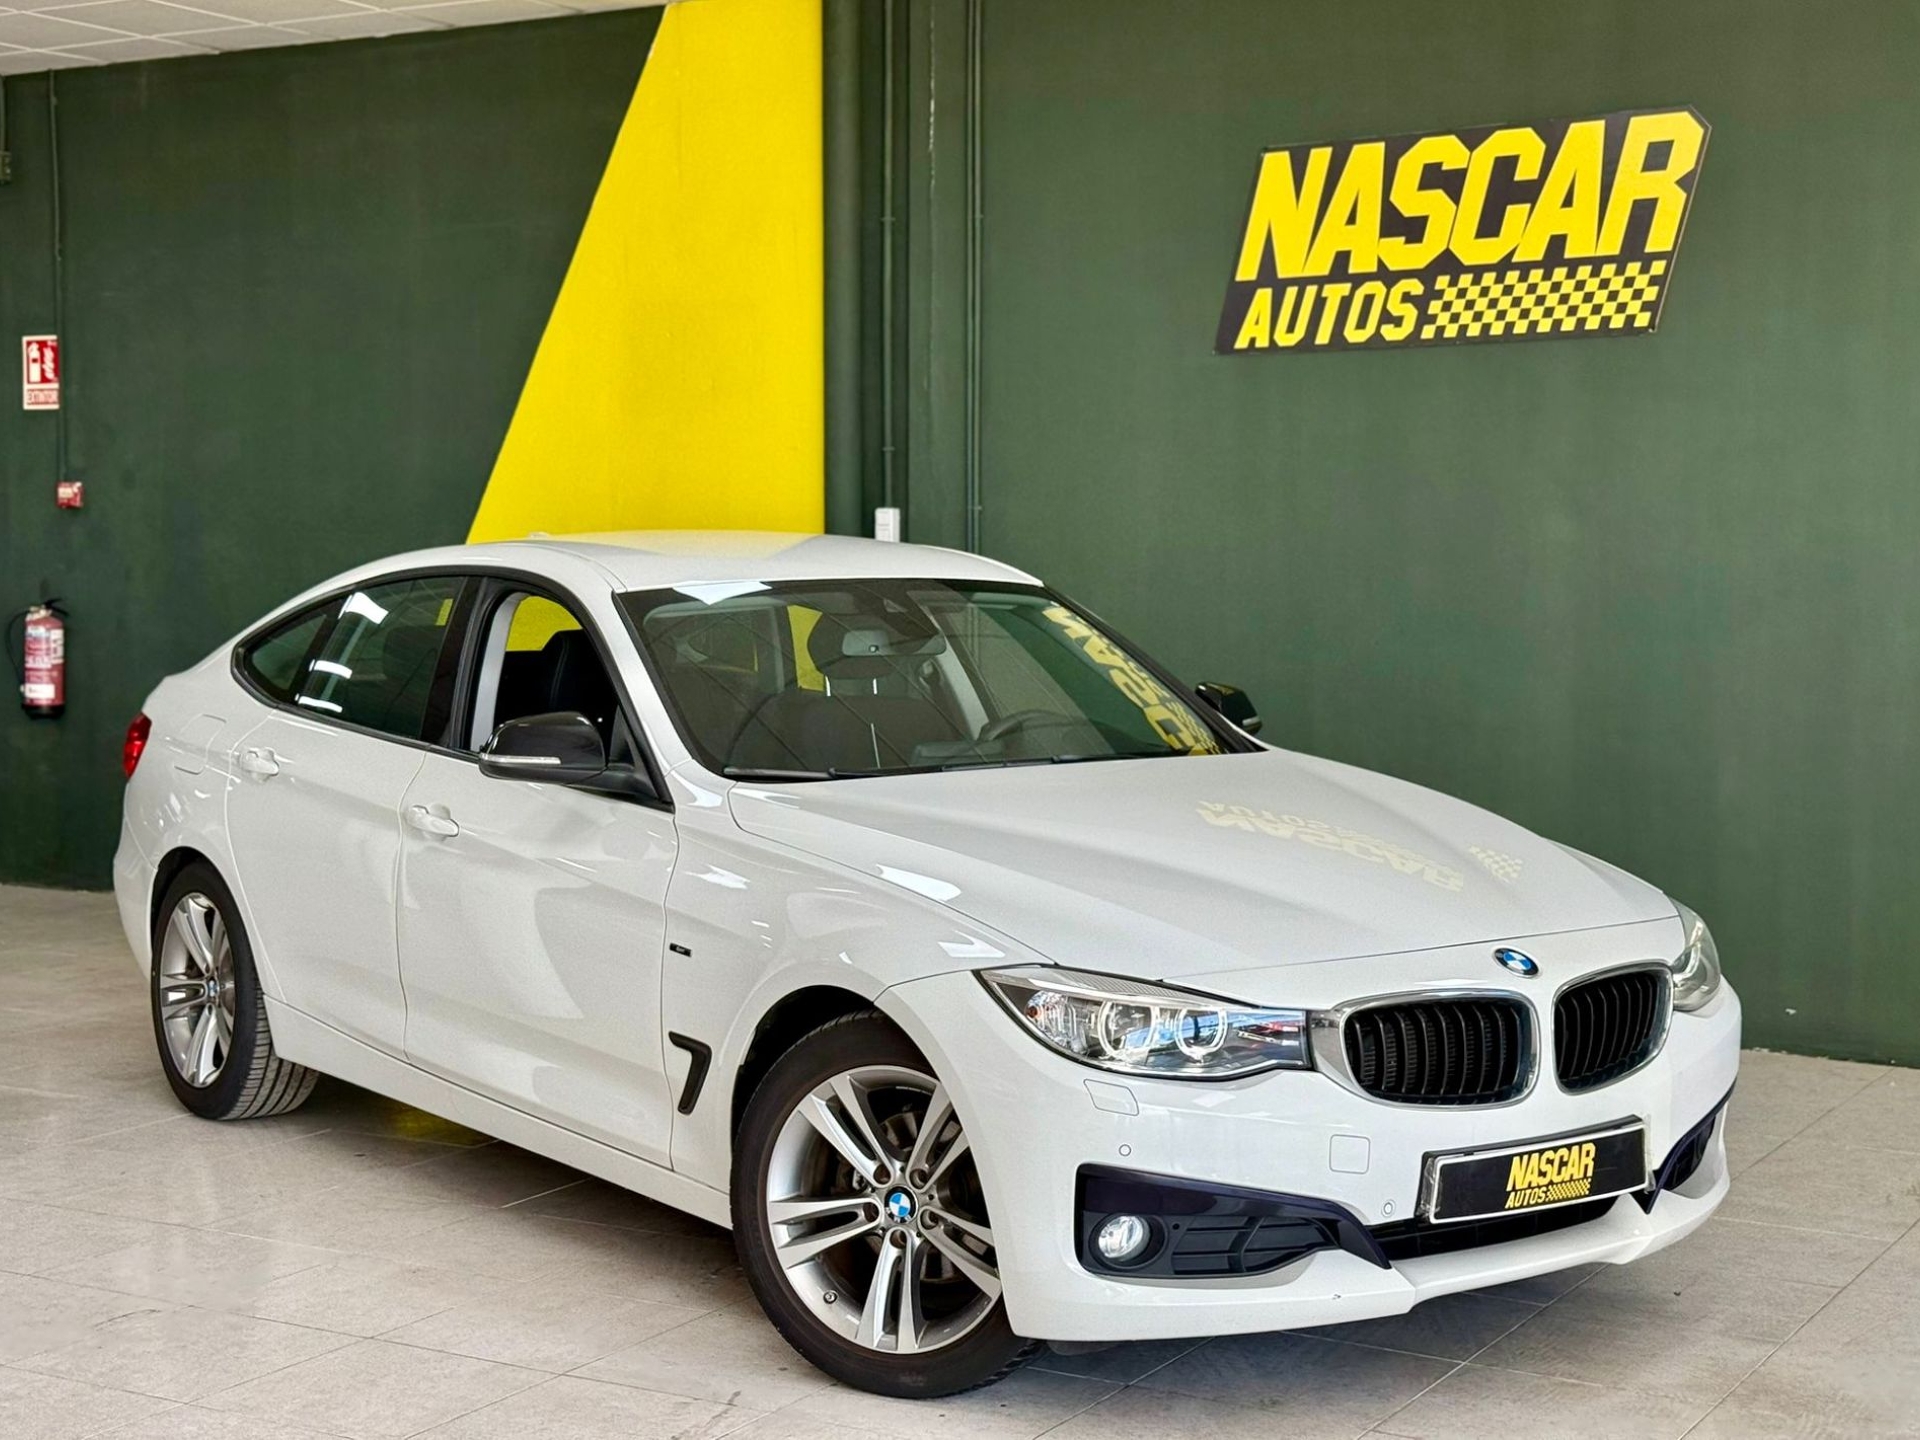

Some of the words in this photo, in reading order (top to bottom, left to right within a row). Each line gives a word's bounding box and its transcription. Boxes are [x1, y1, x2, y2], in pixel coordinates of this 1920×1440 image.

[1235, 111, 1703, 281] NASCAR
[1233, 279, 1424, 349] AUTOS
[1506, 1142, 1596, 1192] NASCAR
[1505, 1186, 1548, 1209] AUTOS
